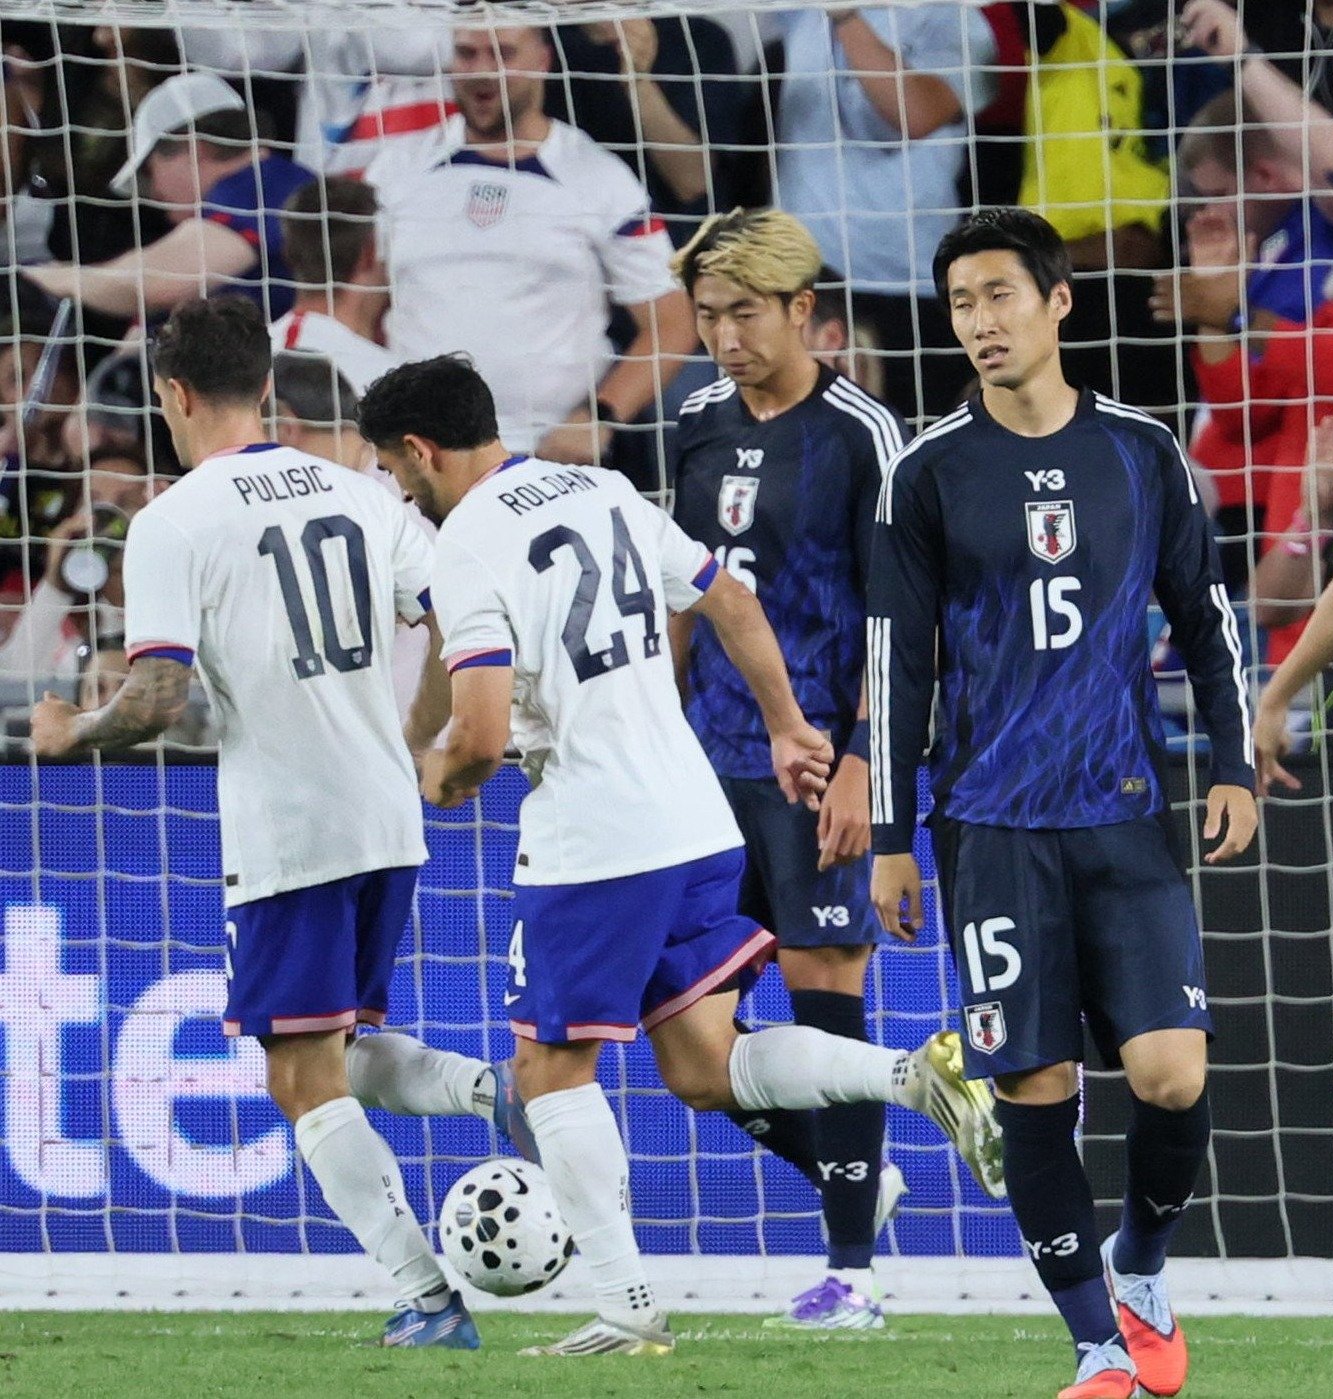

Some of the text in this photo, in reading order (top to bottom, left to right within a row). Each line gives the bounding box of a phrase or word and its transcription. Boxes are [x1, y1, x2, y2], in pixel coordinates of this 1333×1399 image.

[232, 464, 333, 506] PULISIC
[498, 467, 598, 516] ROLDAN
[1024, 468, 1066, 492] Y-3
[257, 514, 372, 680] 10
[528, 505, 661, 684] 24
[1029, 576, 1083, 651] 15
[811, 905, 850, 928] Y-3
[963, 916, 1022, 995] 15
[817, 1160, 869, 1181] Y-3
[381, 1174, 406, 1218] USA
[1025, 1231, 1080, 1261] Y-3
